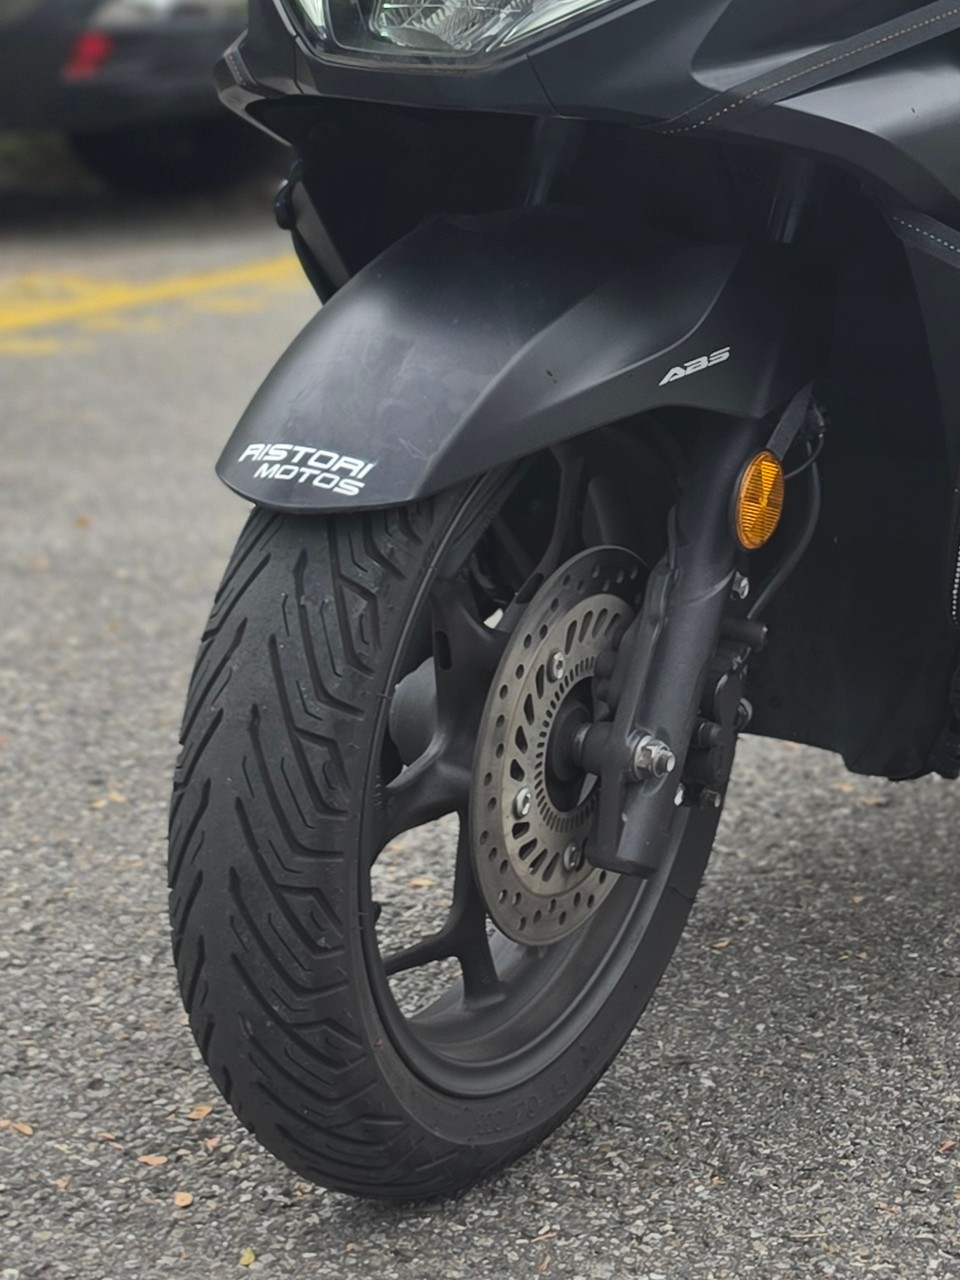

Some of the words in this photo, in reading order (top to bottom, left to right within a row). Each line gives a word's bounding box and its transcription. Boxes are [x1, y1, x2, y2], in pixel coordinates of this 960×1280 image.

[657, 346, 732, 387] ABS
[238, 443, 376, 479] RISTORI
[253, 463, 366, 496] MOTOS
